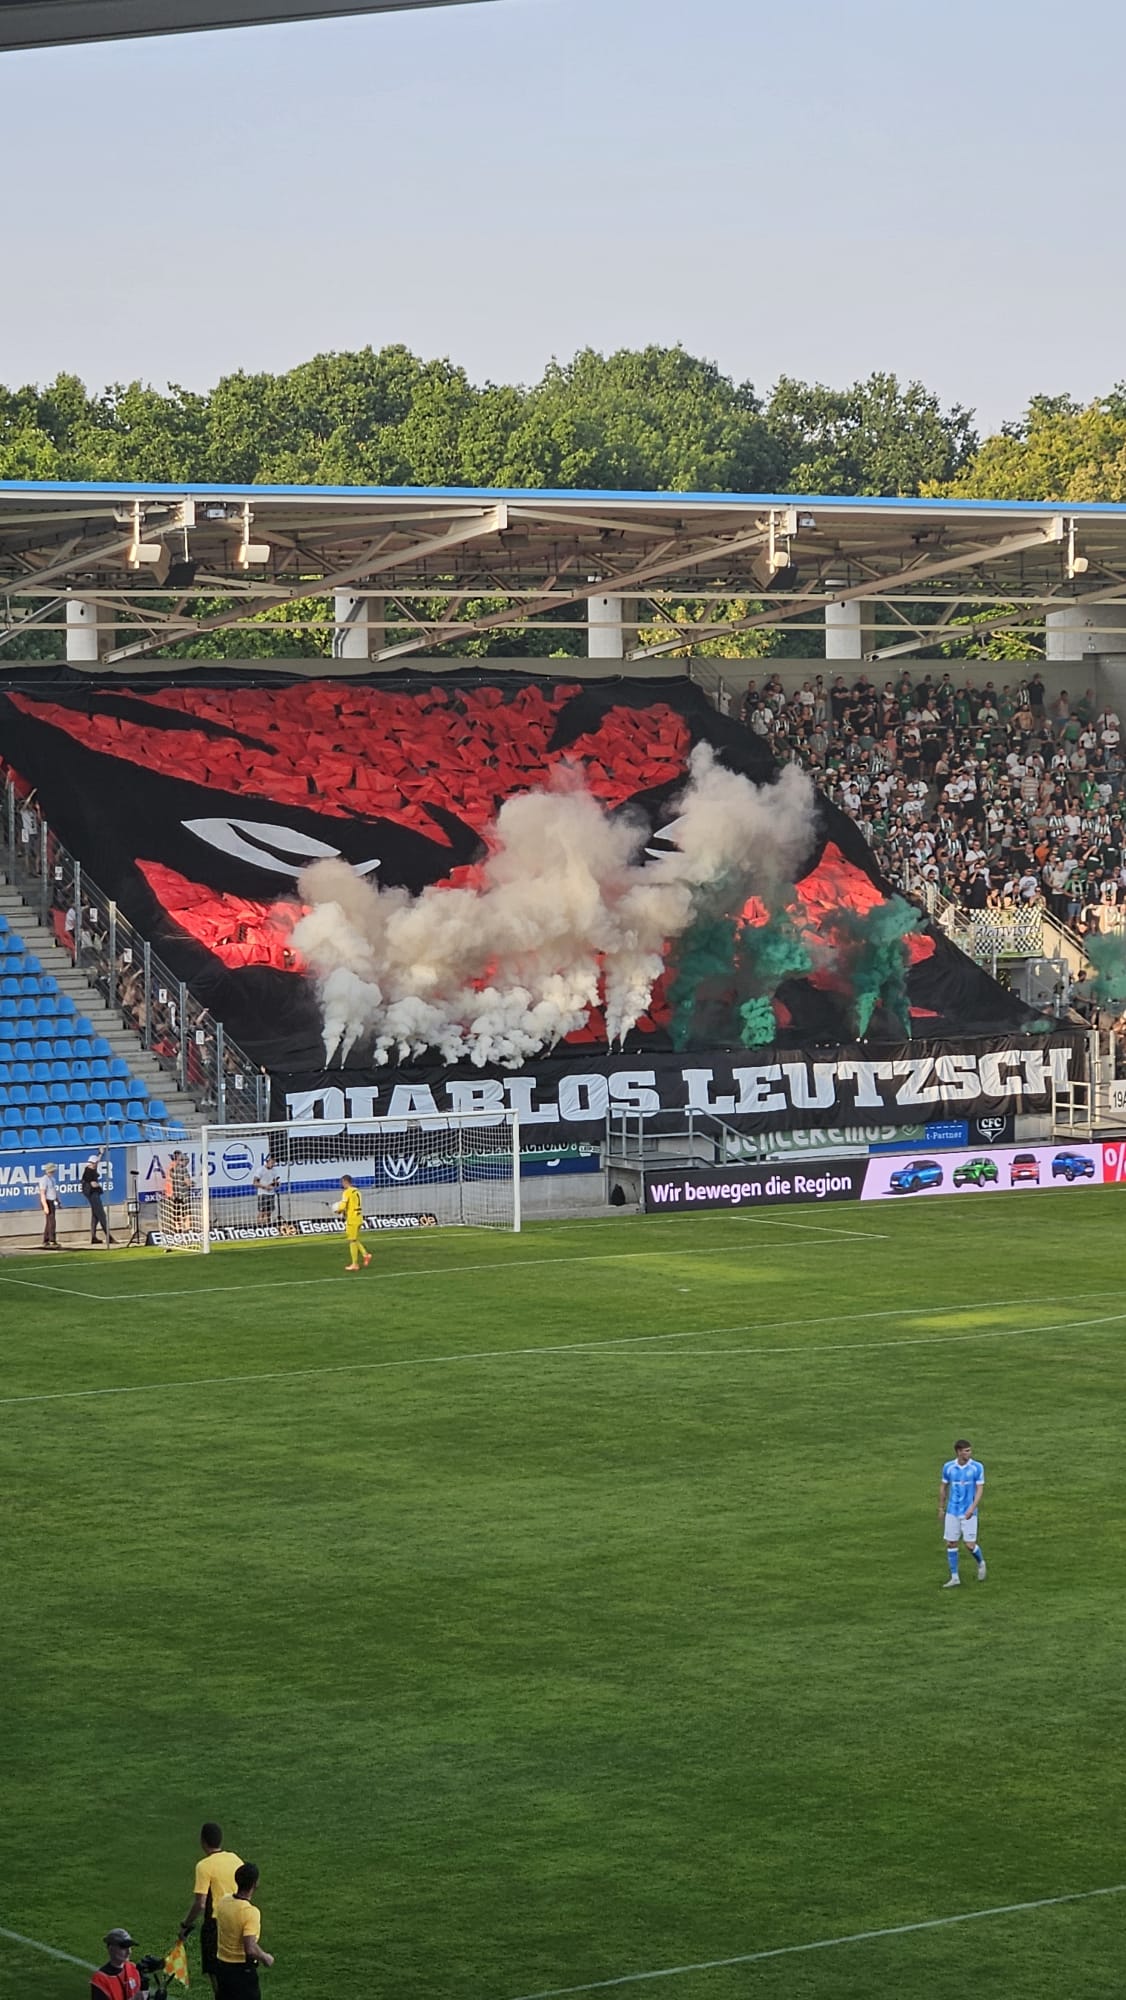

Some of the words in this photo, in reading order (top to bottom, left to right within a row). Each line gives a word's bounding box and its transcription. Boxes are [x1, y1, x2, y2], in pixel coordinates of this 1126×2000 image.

[286, 1070, 660, 1138] DIABLOS
[682, 1048, 1073, 1116] LEUTZSCH
[981, 1117, 1002, 1128] CFC
[0, 1161, 113, 1185] WALHR
[145, 1152, 216, 1180] AIS
[651, 1182, 682, 1203] Wir
[685, 1181, 761, 1203] bewegen
[765, 1175, 791, 1195] die
[794, 1172, 851, 1198] Region
[299, 1218, 369, 1234] Eisenb
